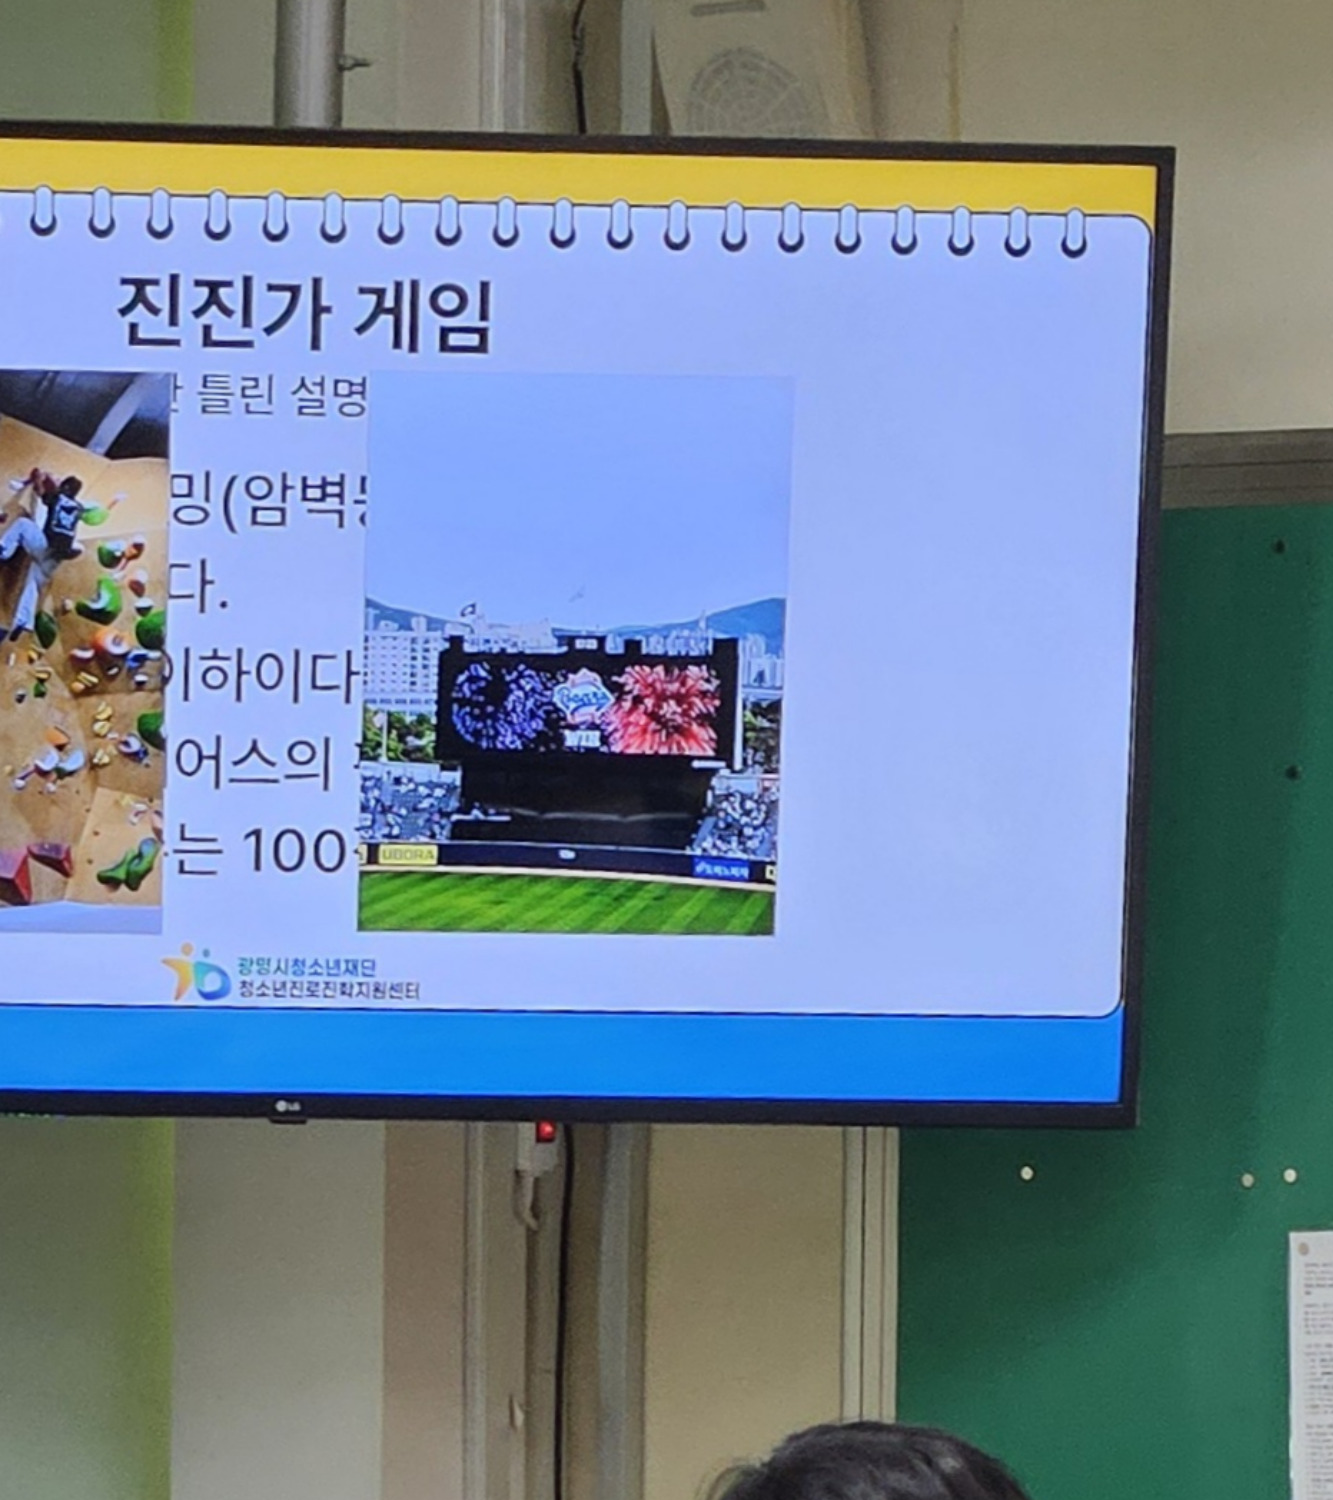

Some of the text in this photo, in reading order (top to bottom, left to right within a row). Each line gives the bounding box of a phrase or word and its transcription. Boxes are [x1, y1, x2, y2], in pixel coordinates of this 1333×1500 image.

[117, 273, 491, 354] 진진가 게임
[197, 374, 274, 415] 틀린
[291, 375, 368, 418] 설명
[168, 558, 228, 614] 다.
[175, 734, 331, 792] 어스의
[164, 823, 359, 876] 는 100
[237, 957, 377, 977] 광명시청소년재단
[239, 980, 421, 1000] 청소년진로진학지원센터
